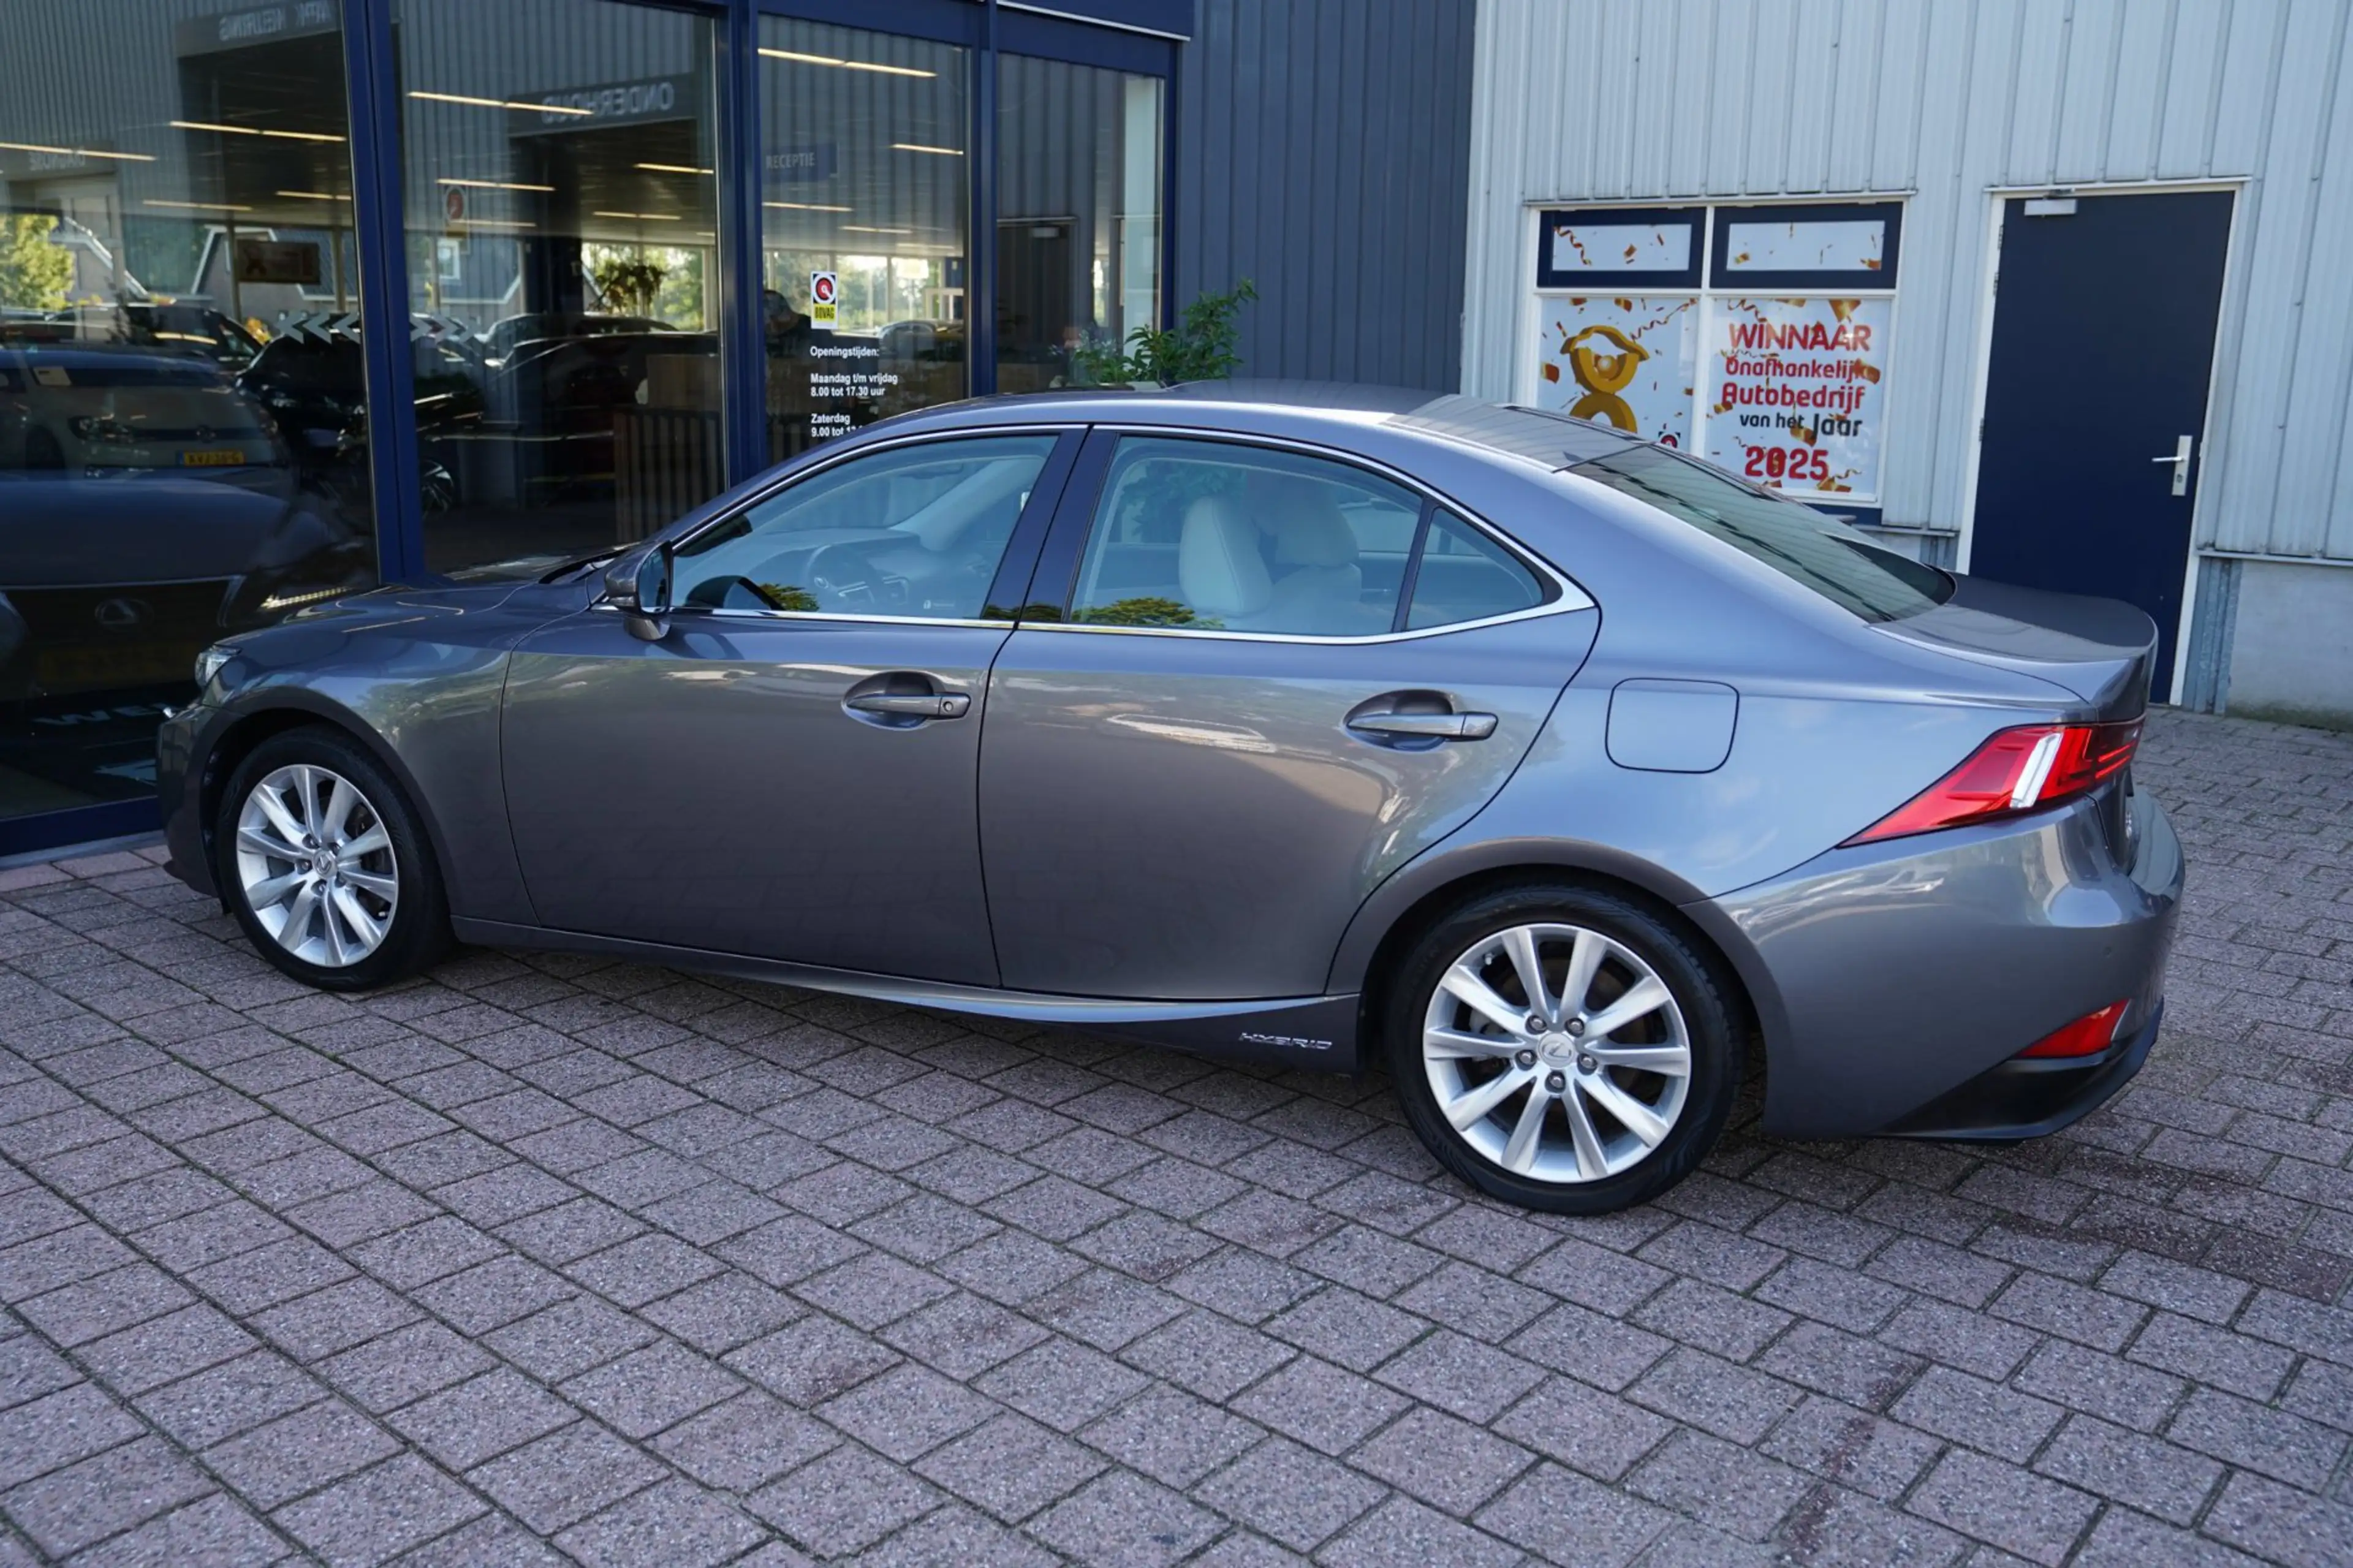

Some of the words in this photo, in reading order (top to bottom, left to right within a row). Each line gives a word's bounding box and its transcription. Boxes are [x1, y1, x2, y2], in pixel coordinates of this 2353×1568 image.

[765, 151, 816, 169] RECEPTIE
[814, 306, 835, 319] BOVAG
[1729, 323, 1872, 352] WINNAAR
[809, 346, 879, 359] Openingstijden:
[810, 373, 851, 385] Maandag
[852, 373, 866, 383] t/m
[868, 373, 898, 385] vrijdag
[810, 387, 829, 397] 8.00
[831, 387, 844, 396] tot
[846, 386, 868, 396] 17.30
[870, 387, 886, 396] uur
[1721, 382, 1865, 414] Autobedrijf
[811, 413, 851, 425] Zaterdag
[1740, 414, 1770, 428] van
[1775, 412, 1805, 430] het
[1812, 413, 1863, 441] Jaar
[811, 427, 830, 437] 9.00
[832, 426, 844, 436] tot
[1745, 445, 1830, 480] 2025
[1238, 1032, 1333, 1050] HYBRID
